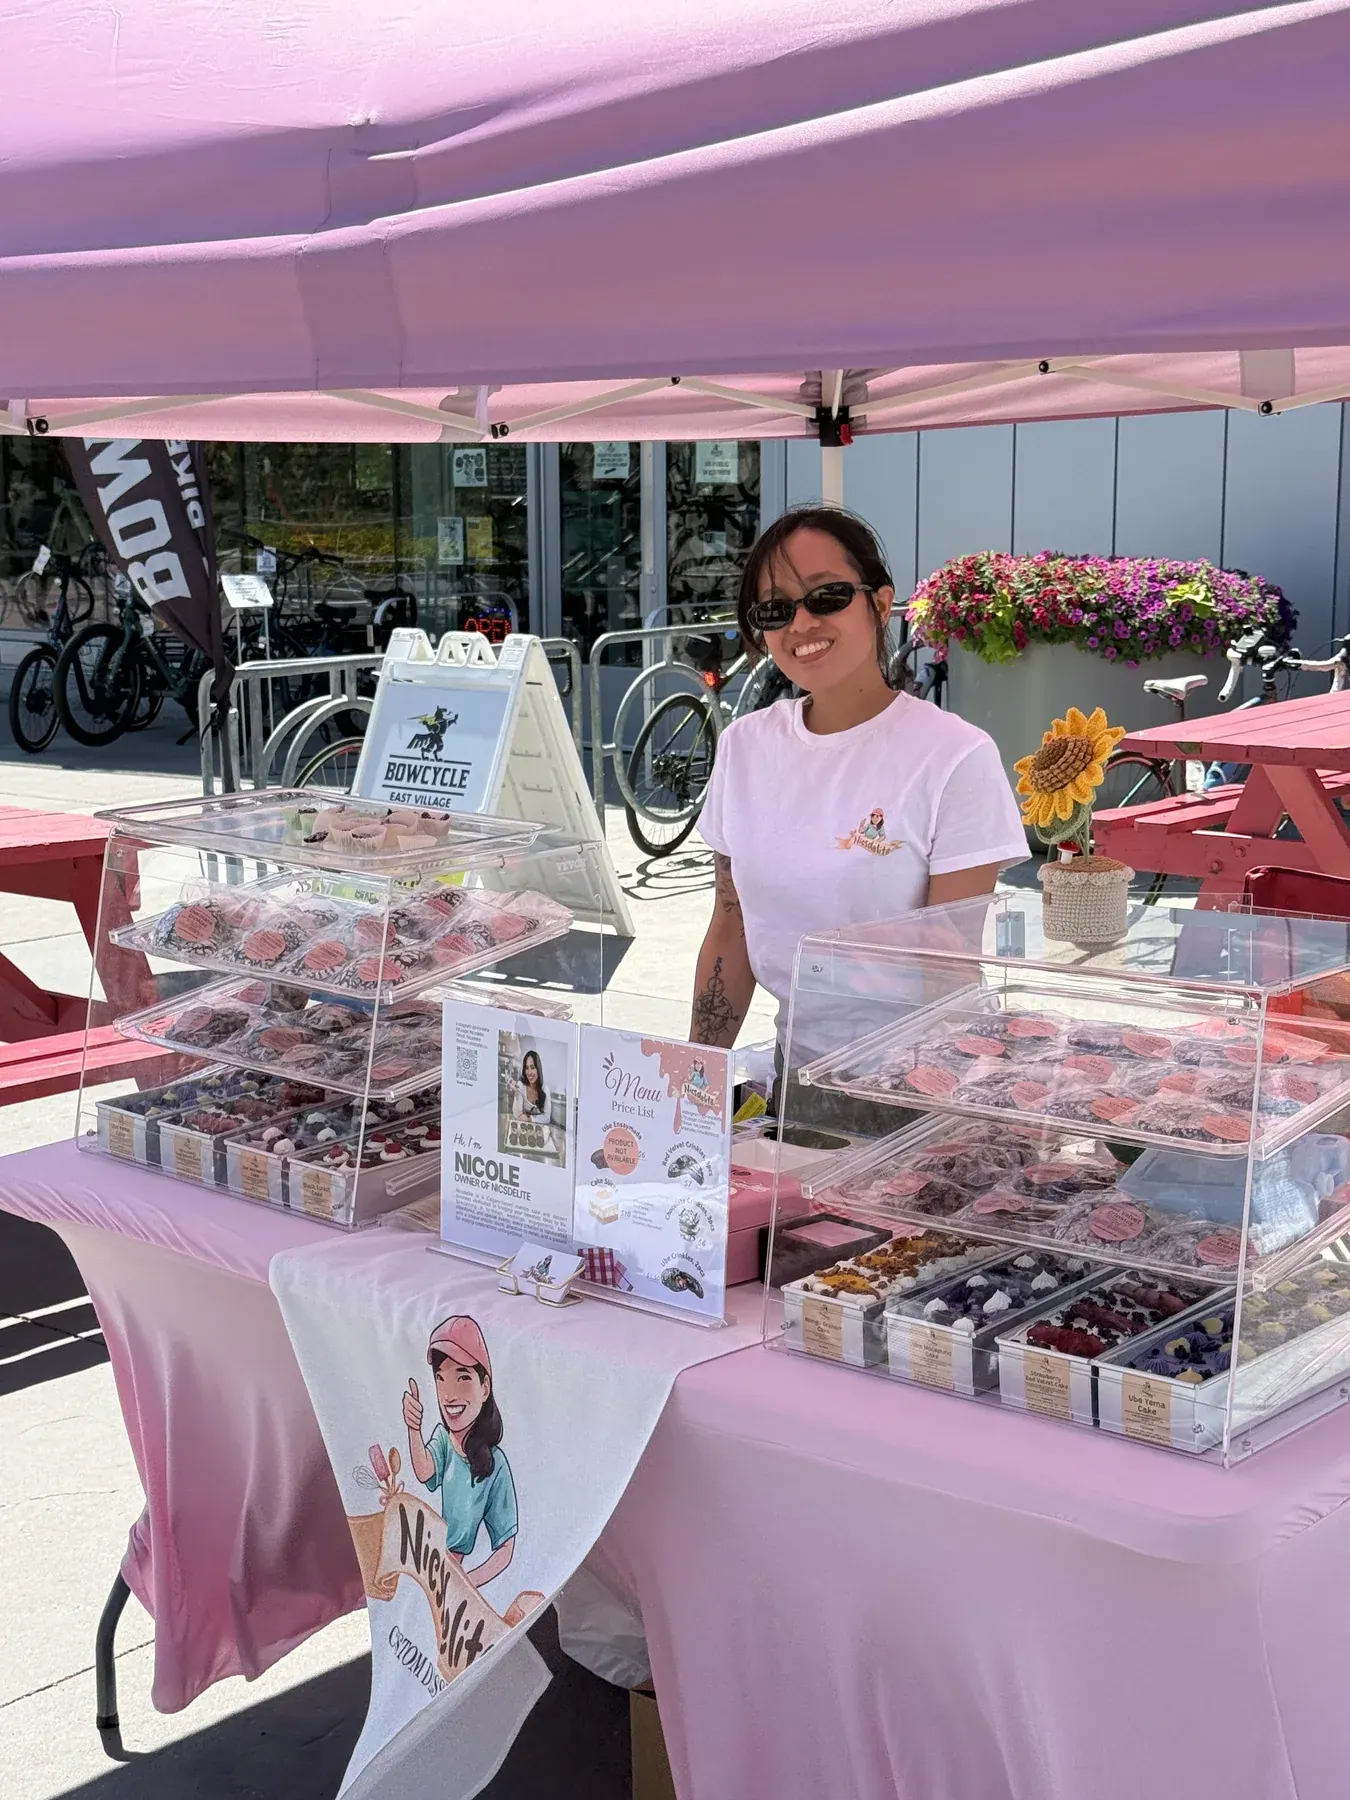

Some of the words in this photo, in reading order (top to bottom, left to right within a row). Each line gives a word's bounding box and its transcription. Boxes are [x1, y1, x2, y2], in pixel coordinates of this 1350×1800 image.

[83, 437, 192, 608] BOW
[384, 761, 470, 789] BOWCYCLE
[389, 791, 412, 804] EAST
[414, 794, 452, 809] VILLAGE
[604, 1067, 662, 1102] Menu
[612, 1100, 635, 1115] Price
[638, 1104, 655, 1119] List
[602, 1122, 612, 1133] Ube
[608, 1138, 634, 1148] PRODUCT
[615, 1147, 628, 1156] NOT
[662, 1152, 670, 1166] Red
[668, 1141, 685, 1154] Velvet
[606, 1153, 636, 1165] AVAILABLE
[454, 1151, 520, 1188] NICOLE
[454, 1173, 480, 1187] OWNER
[480, 1180, 490, 1189] OF
[491, 1184, 532, 1201] NICSDELITE
[590, 1178, 604, 1187] Cake
[661, 1256, 671, 1267] Ube
[1030, 1370, 1061, 1383] Strawberry
[1036, 1378, 1053, 1386] Velvet
[1128, 1394, 1142, 1403] Ube
[1138, 1405, 1157, 1415] Cake
